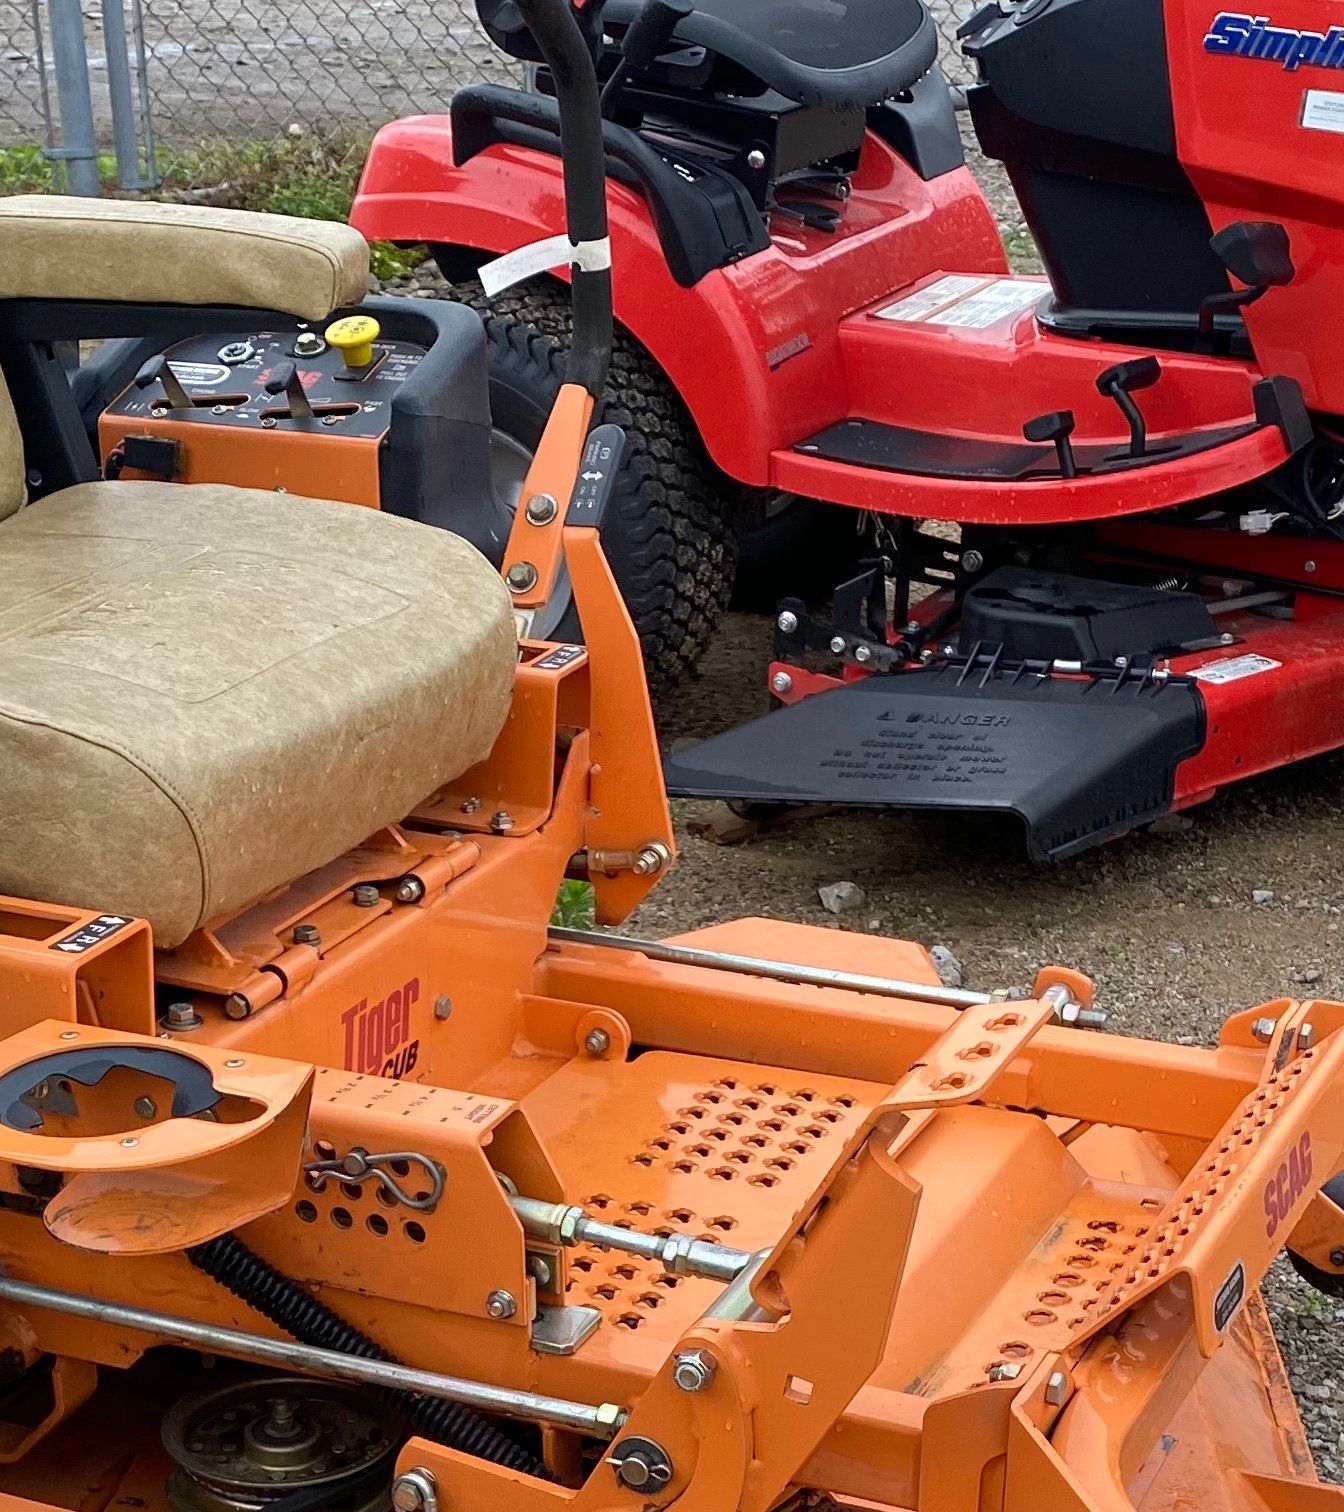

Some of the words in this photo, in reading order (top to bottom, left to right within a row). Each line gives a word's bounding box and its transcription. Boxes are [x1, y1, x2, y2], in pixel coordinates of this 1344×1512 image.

[906, 711, 1012, 728] DANGER
[76, 935, 100, 944] R
[89, 924, 107, 932] F
[341, 977, 420, 1076] Tiger
[381, 1039, 420, 1080] CUB
[1263, 1131, 1313, 1239] SCAG
